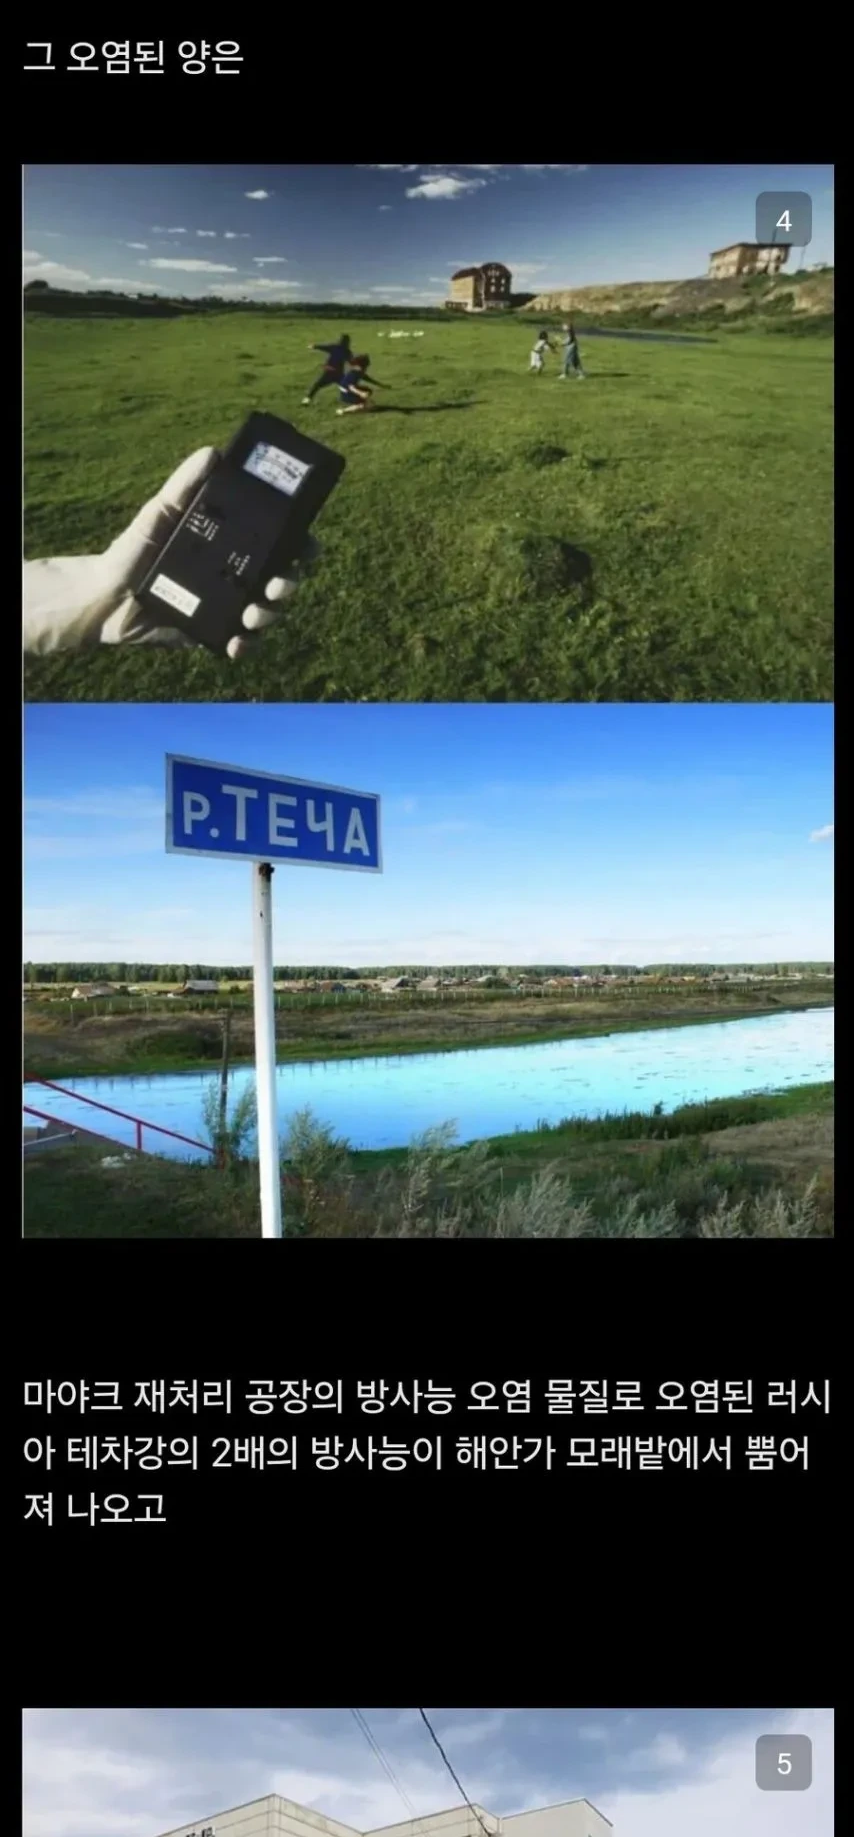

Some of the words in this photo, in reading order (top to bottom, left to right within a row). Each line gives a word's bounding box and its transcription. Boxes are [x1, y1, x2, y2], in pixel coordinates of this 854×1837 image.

[24, 43, 55, 69] 그
[67, 41, 164, 73] 오염된
[178, 40, 243, 74] 양은
[24, 1492, 52, 1526] 져
[68, 1492, 166, 1526] 나오고
